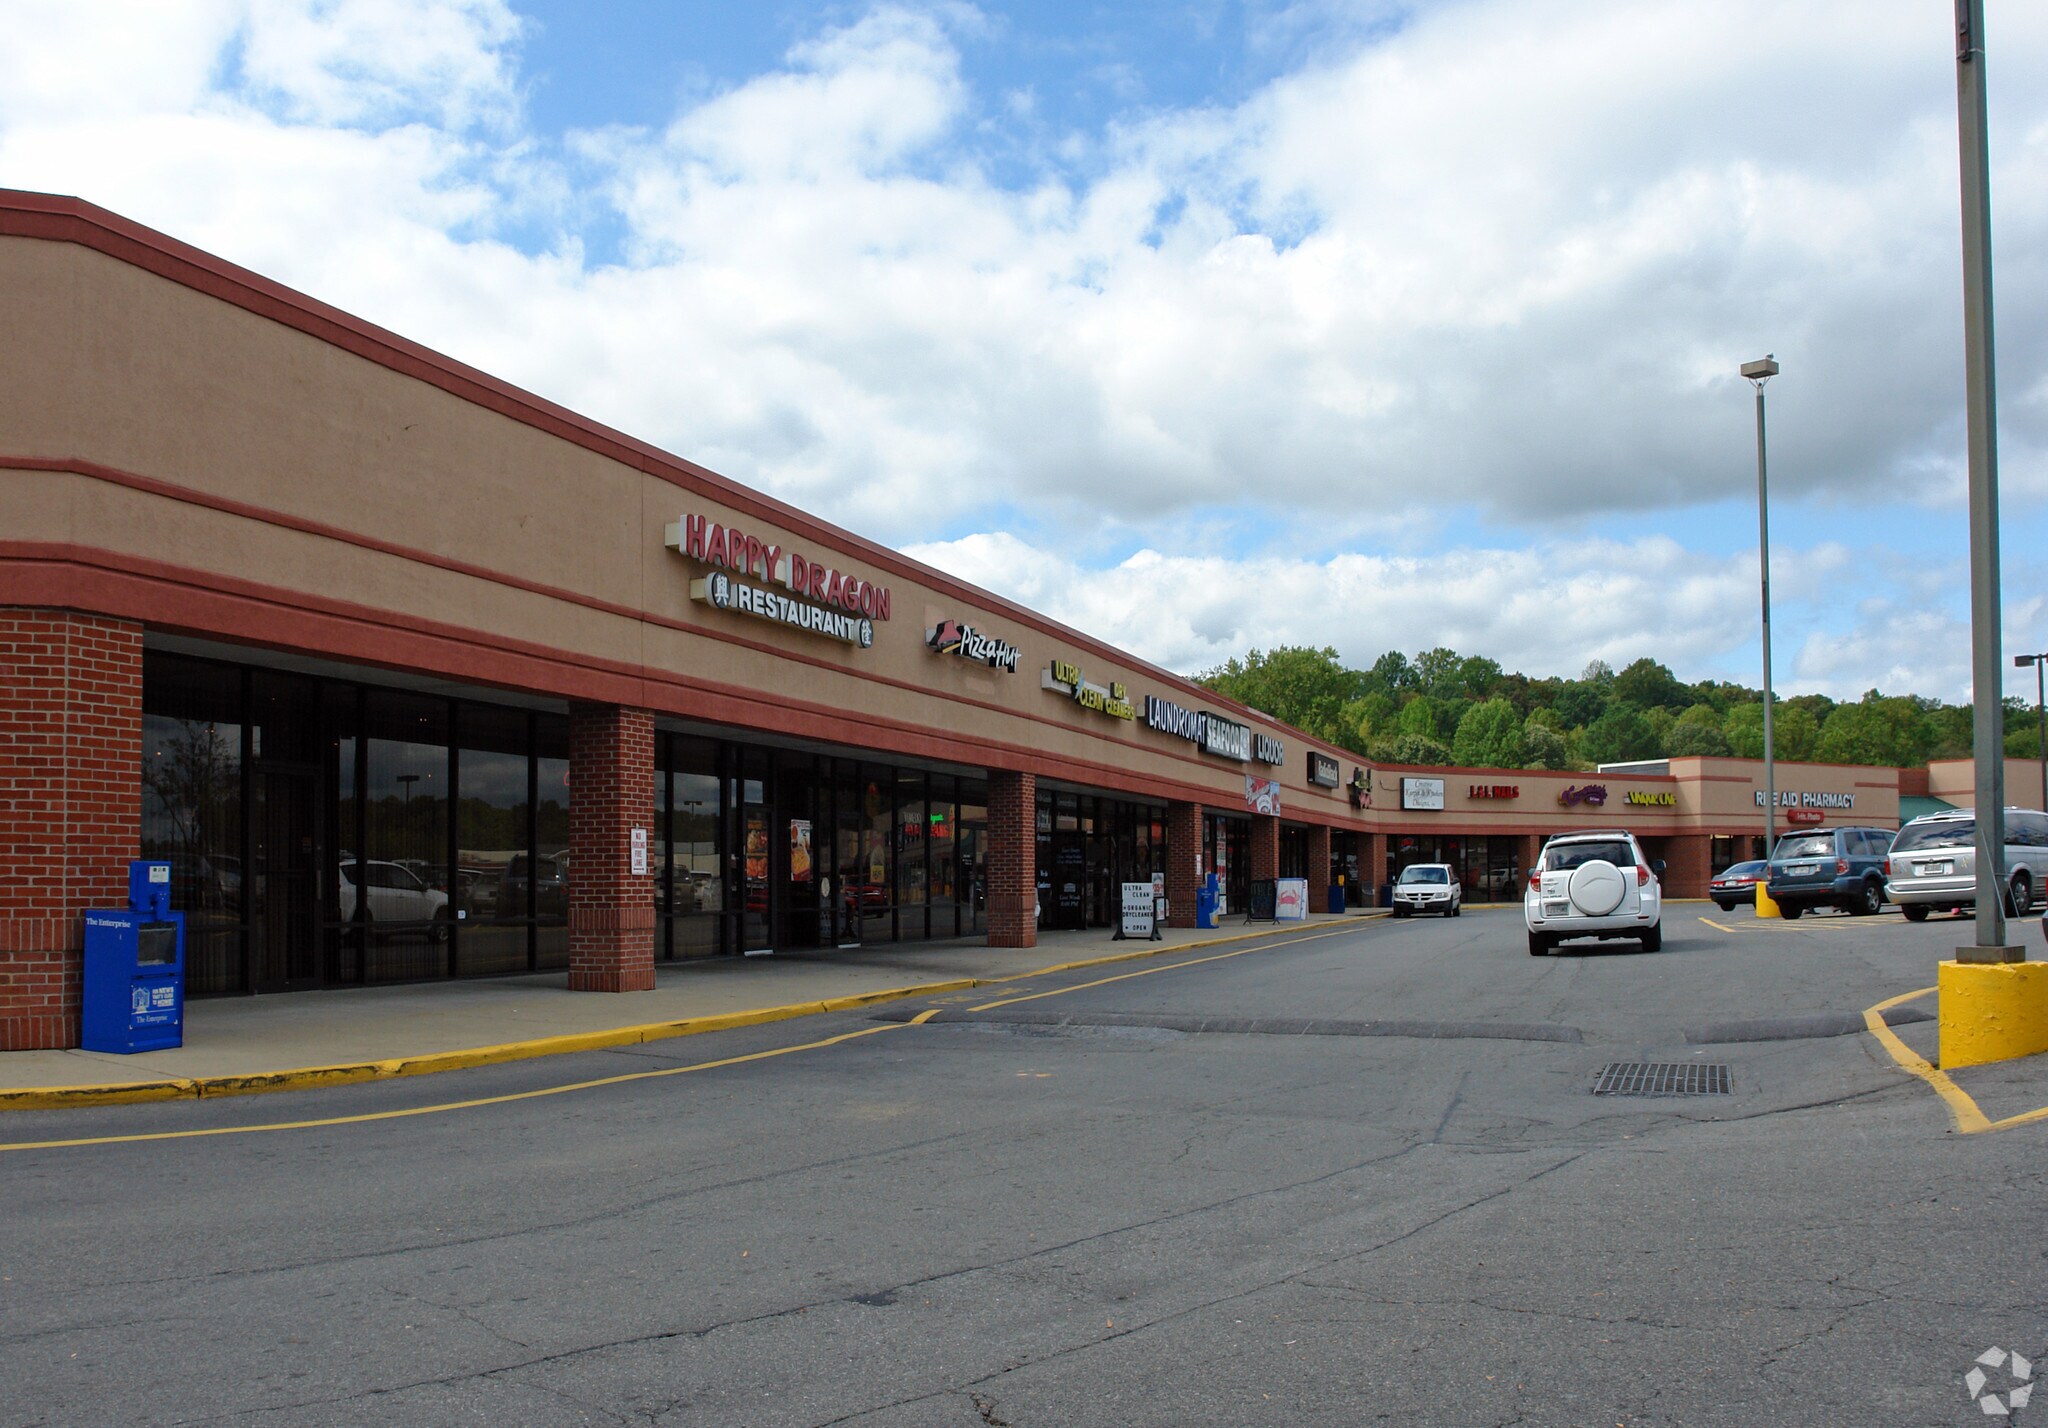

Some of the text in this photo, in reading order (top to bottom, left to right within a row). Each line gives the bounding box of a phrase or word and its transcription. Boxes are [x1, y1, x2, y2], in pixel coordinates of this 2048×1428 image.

[684, 514, 891, 621] HAPPY DRAGON
[737, 584, 855, 640] RESTAURANT
[960, 624, 1022, 672] Pizza Hut
[1055, 660, 1079, 685] ULTRA
[1080, 687, 1104, 711] CLEAN
[1113, 681, 1127, 699] DRY
[1105, 697, 1135, 721] CLEANERS
[1148, 695, 1207, 745] LAUNDROMAT
[1207, 716, 1240, 755] SEAFOOD
[1257, 733, 1283, 766] LIQUOR
[1492, 785, 1520, 799] NAILS
[1755, 791, 1856, 808] RIE AID PHARMACY
[86, 917, 131, 928] The Enterprise
